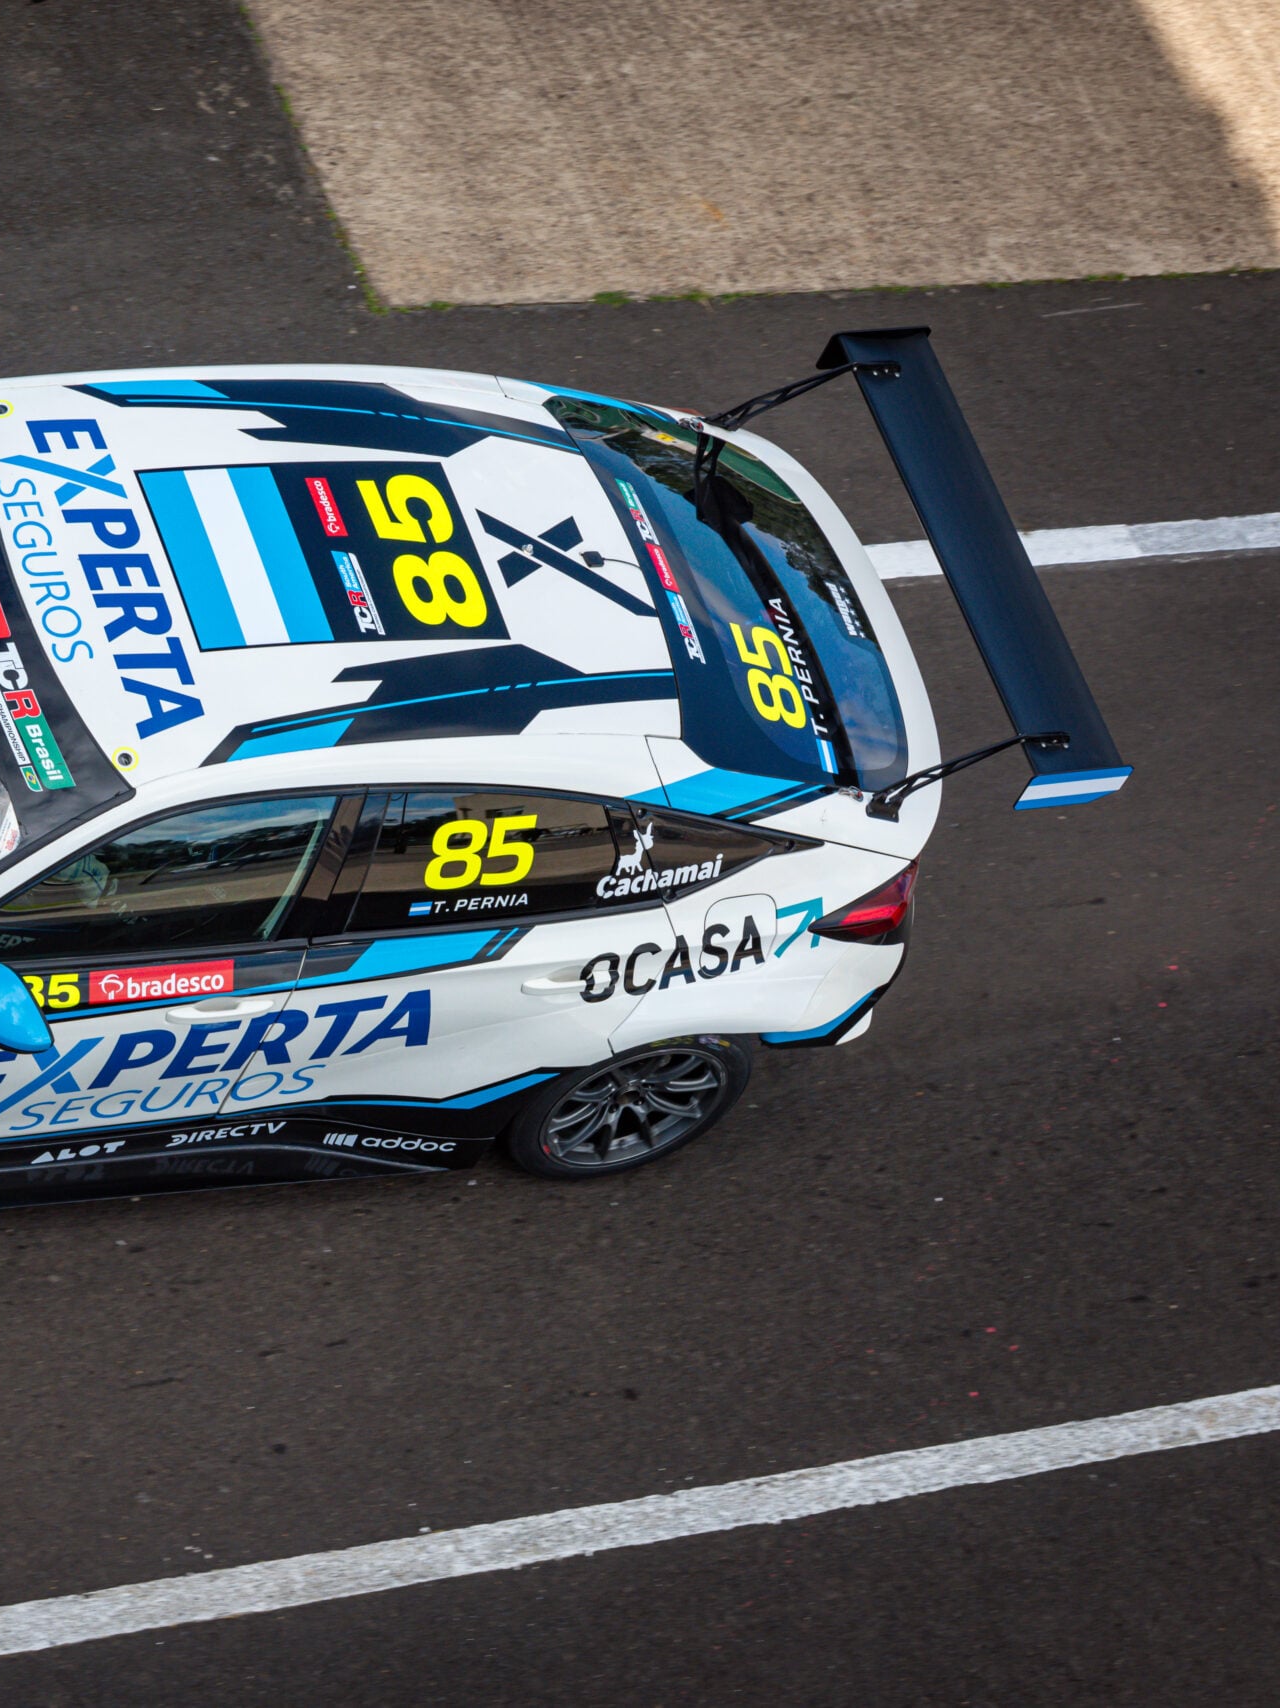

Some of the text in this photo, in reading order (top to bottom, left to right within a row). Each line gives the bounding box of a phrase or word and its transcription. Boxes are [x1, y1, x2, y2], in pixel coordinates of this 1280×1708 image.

[314, 480, 337, 522] bradesco
[354, 473, 489, 629] 85
[347, 589, 377, 634] TCR
[768, 596, 819, 705] PERNIA
[729, 621, 807, 730] 85
[25, 723, 65, 782] Brasil
[424, 813, 539, 891] 85
[596, 853, 724, 900] Cachamai
[433, 893, 529, 914] T. PERNIA
[579, 914, 766, 1004] OCASA
[127, 973, 225, 998] bradesco
[9, 1063, 327, 1131] SEGUROS
[30, 1140, 127, 1165] ALOT
[165, 1121, 287, 1148] DIRECTV
[361, 1136, 457, 1152] addoc
